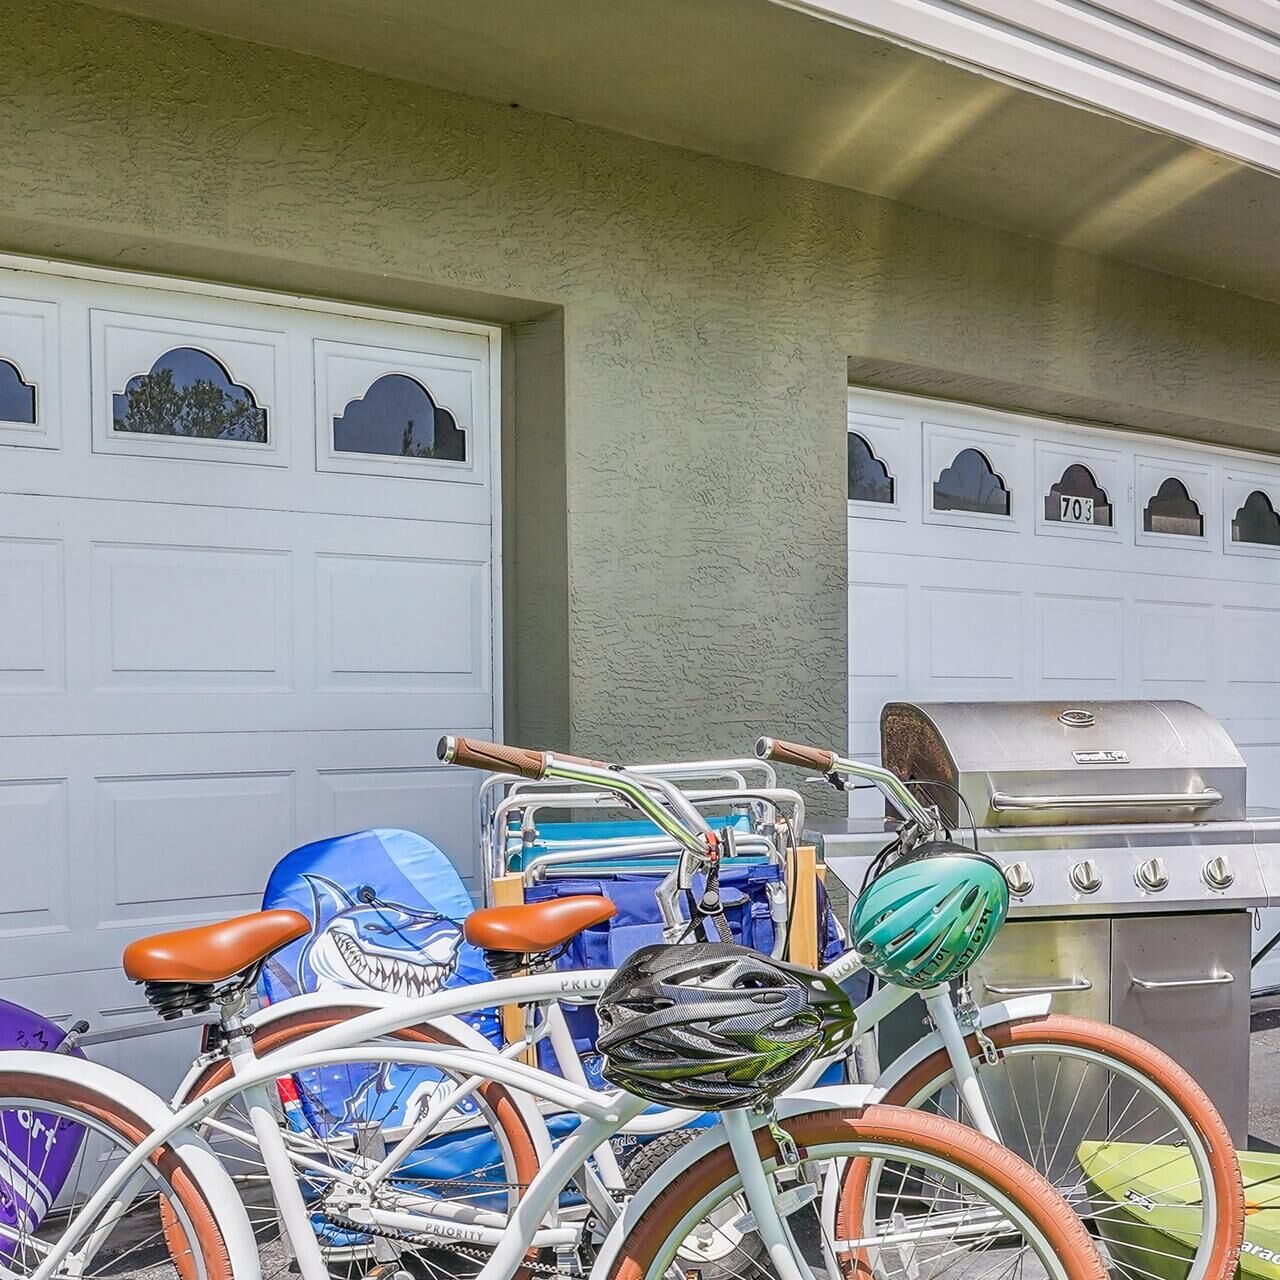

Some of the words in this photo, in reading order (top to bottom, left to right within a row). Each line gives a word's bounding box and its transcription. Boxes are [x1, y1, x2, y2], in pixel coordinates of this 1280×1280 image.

[927, 948, 950, 968] 701
[830, 957, 861, 979] RIOR
[560, 978, 608, 991] PRIO
[425, 1223, 485, 1241] PRIORITY
